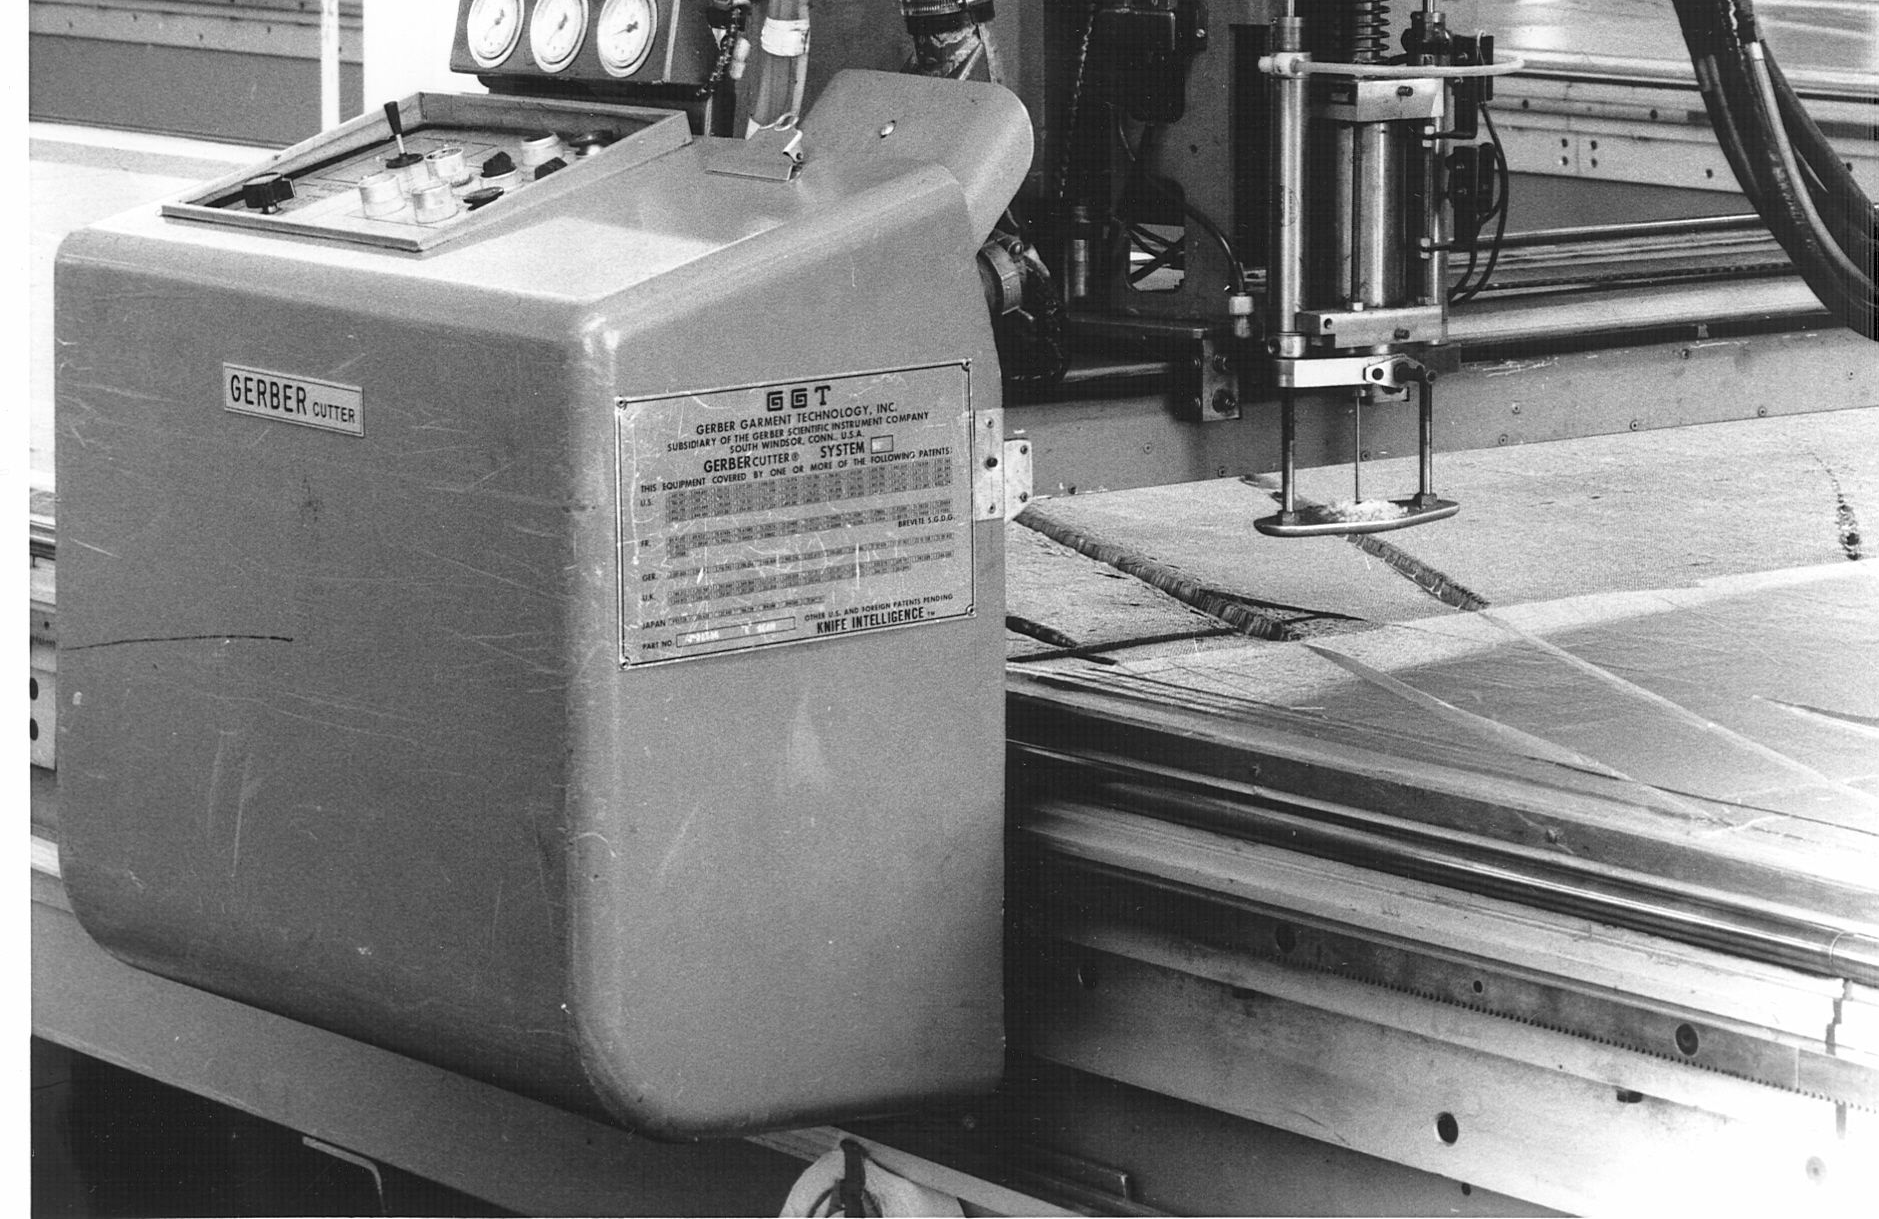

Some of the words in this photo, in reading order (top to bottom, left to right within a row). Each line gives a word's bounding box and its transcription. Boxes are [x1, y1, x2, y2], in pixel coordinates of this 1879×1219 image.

[230, 374, 308, 416] GERBER
[312, 401, 356, 424] CUTTER
[766, 385, 831, 412] GGT
[667, 437, 717, 452] SUBSIDIARY
[720, 435, 732, 444] OF
[735, 433, 750, 443] THE
[752, 428, 784, 441] GERBER
[788, 423, 829, 436] SCIENTIFIC
[831, 416, 883, 431] INSTRUMENT
[886, 411, 929, 424] COMPANY
[696, 421, 736, 435] GERBER
[740, 414, 792, 430] GARMENT
[797, 405, 873, 423] TECHNOLOGY,
[876, 402, 898, 414] INC.
[730, 440, 758, 454] SOUTH
[820, 441, 865, 458] SYSTEM
[640, 483, 657, 493] THIS
[662, 477, 706, 491] EQUIPMENT
[712, 472, 747, 484] COVERED
[753, 470, 763, 479] BY
[770, 466, 786, 477] ONE
[792, 464, 804, 474] OR
[810, 461, 832, 471] MORE
[837, 459, 848, 468] OF
[853, 456, 866, 465] THE
[870, 450, 915, 463] FOLLOWING
[804, 612, 825, 622] OTHER
[844, 606, 859, 616] AND
[862, 602, 891, 613] FOREIGN
[893, 598, 921, 608] PATENTS
[923, 593, 954, 604] PENDING
[816, 617, 848, 634] KNIFE
[851, 606, 925, 629] INTELLIGENCE
[641, 619, 667, 630] JAPAN
[642, 641, 659, 650] PART
